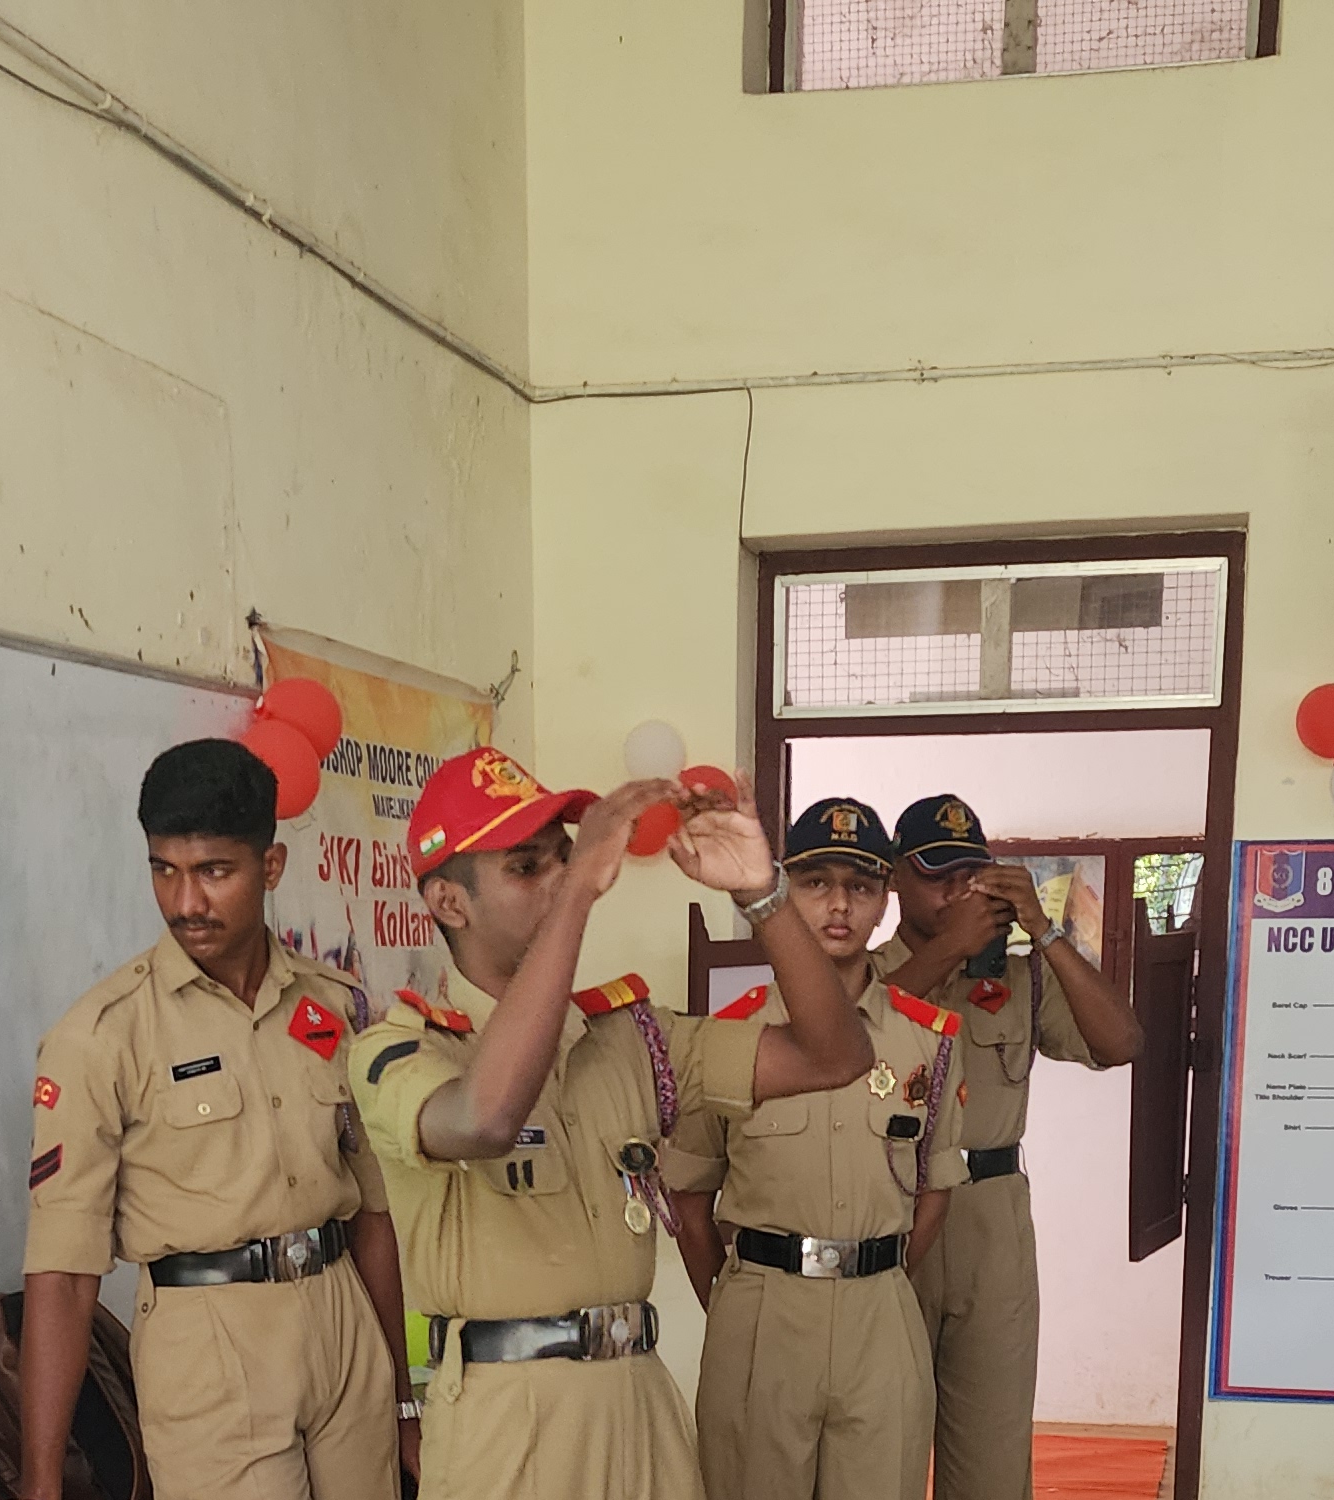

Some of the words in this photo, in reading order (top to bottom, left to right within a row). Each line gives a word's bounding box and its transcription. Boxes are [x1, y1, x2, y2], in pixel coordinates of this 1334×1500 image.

[319, 737, 363, 778] SHOP
[366, 743, 413, 787] MOORE
[1317, 867, 1333, 896] 8
[1266, 926, 1315, 953] NCC
